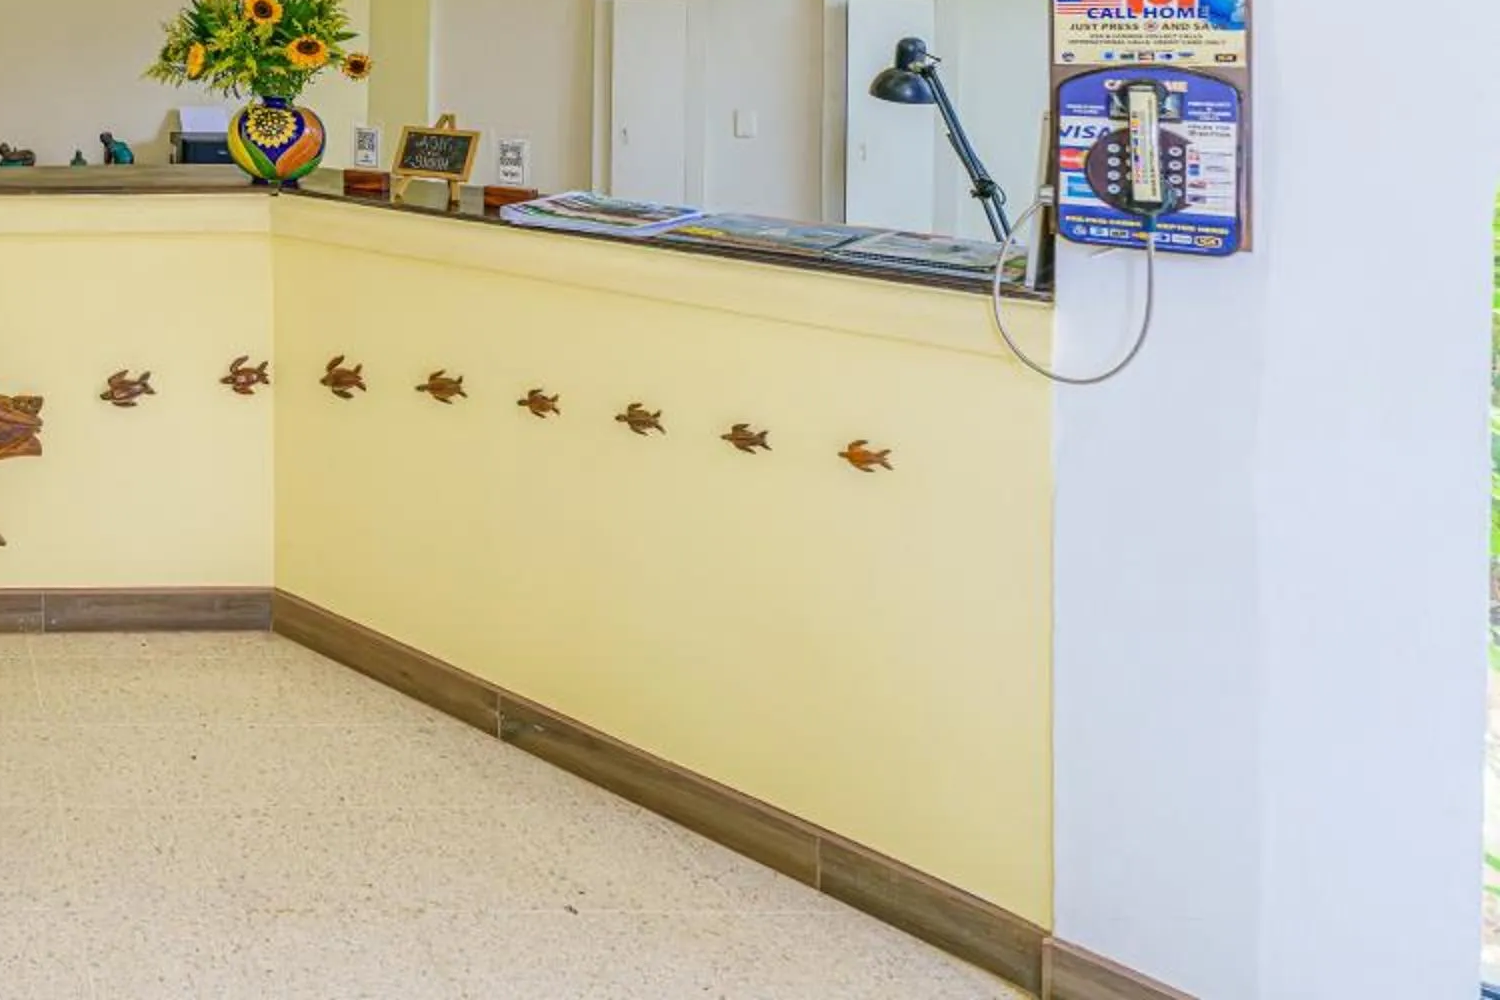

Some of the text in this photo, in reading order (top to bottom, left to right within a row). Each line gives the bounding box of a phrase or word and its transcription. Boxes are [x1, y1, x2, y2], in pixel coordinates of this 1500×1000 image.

[1087, 7, 1209, 19] CALL HOME
[1069, 23, 1139, 31] JUST PRESS
[1161, 23, 1190, 31] AND
[1060, 124, 1112, 139] VISA
